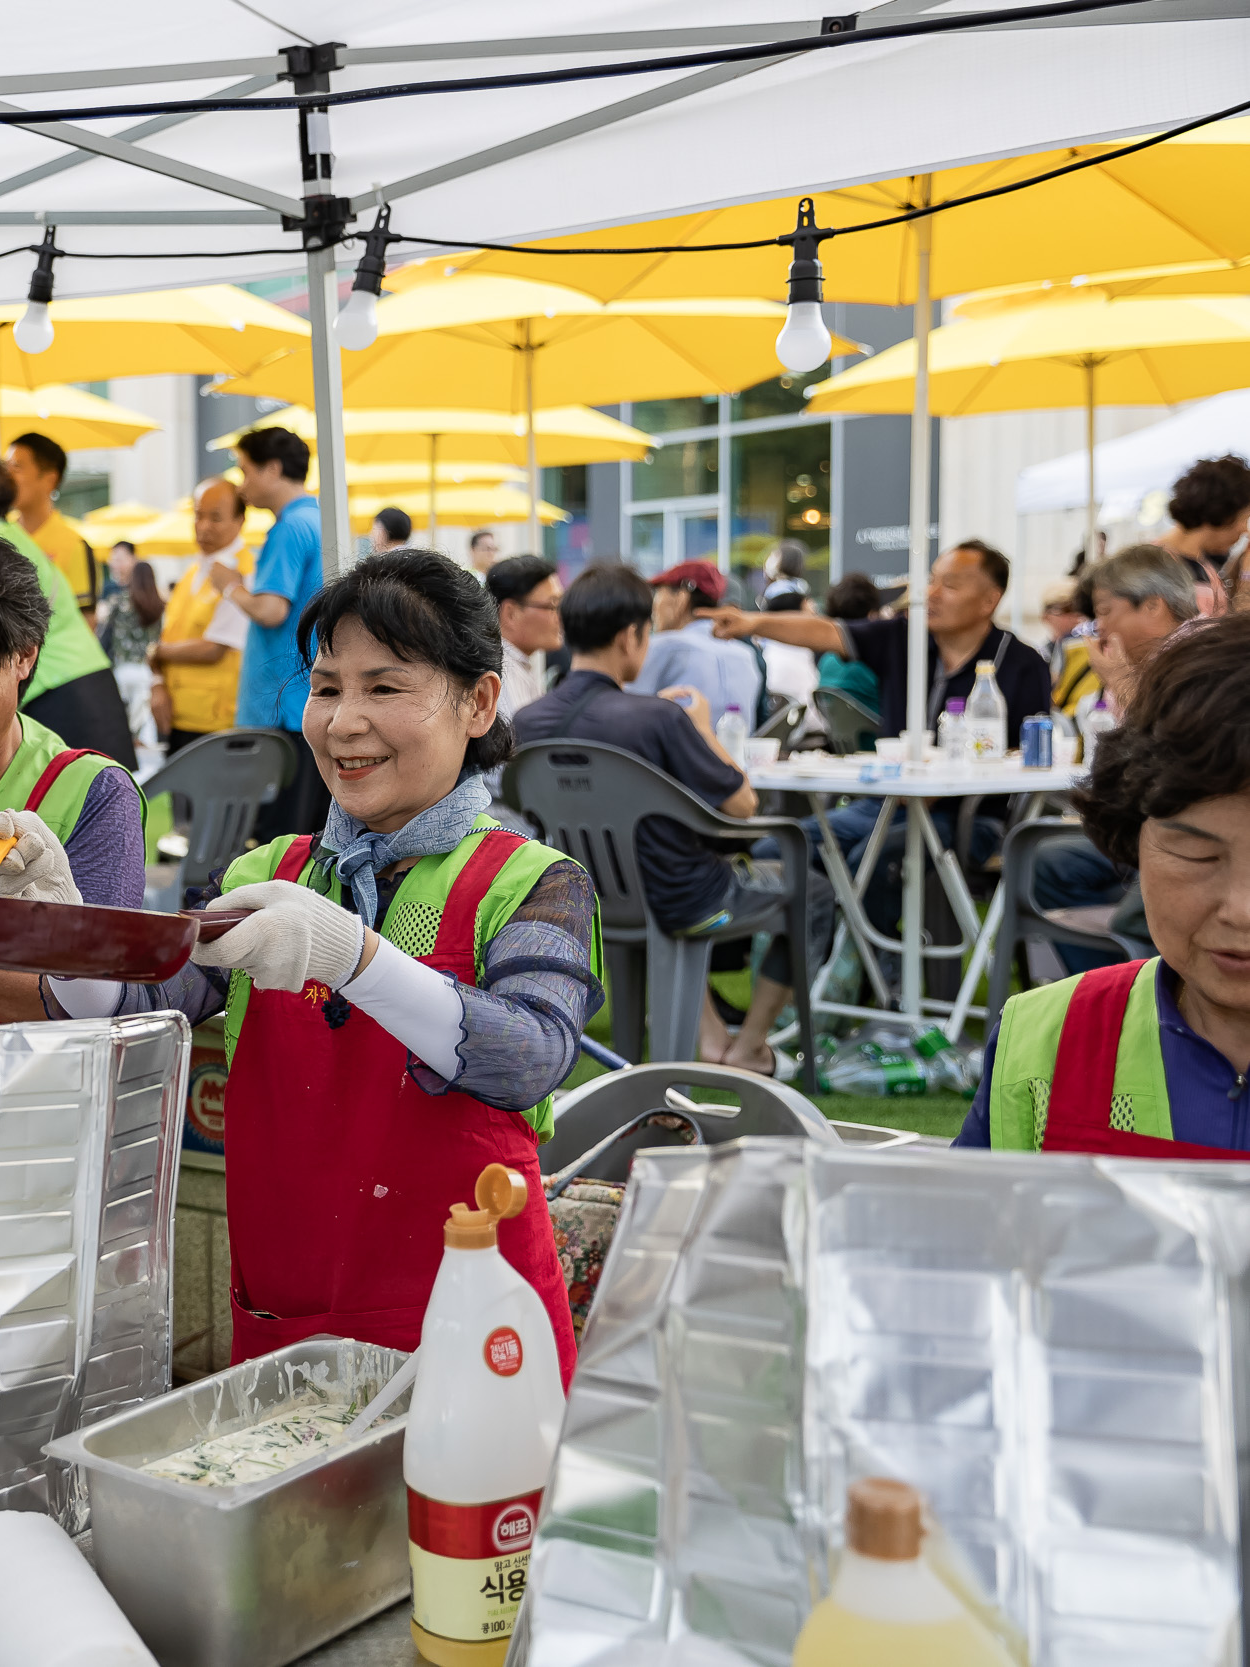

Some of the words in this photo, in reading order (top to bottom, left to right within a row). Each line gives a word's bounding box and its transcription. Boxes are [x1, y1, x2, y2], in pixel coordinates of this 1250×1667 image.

[304, 984, 330, 1004] 자원
[500, 1517, 529, 1537] 해표
[494, 1559, 511, 1573] 맑고
[513, 1554, 532, 1569] 신선
[480, 1569, 527, 1605] 식용
